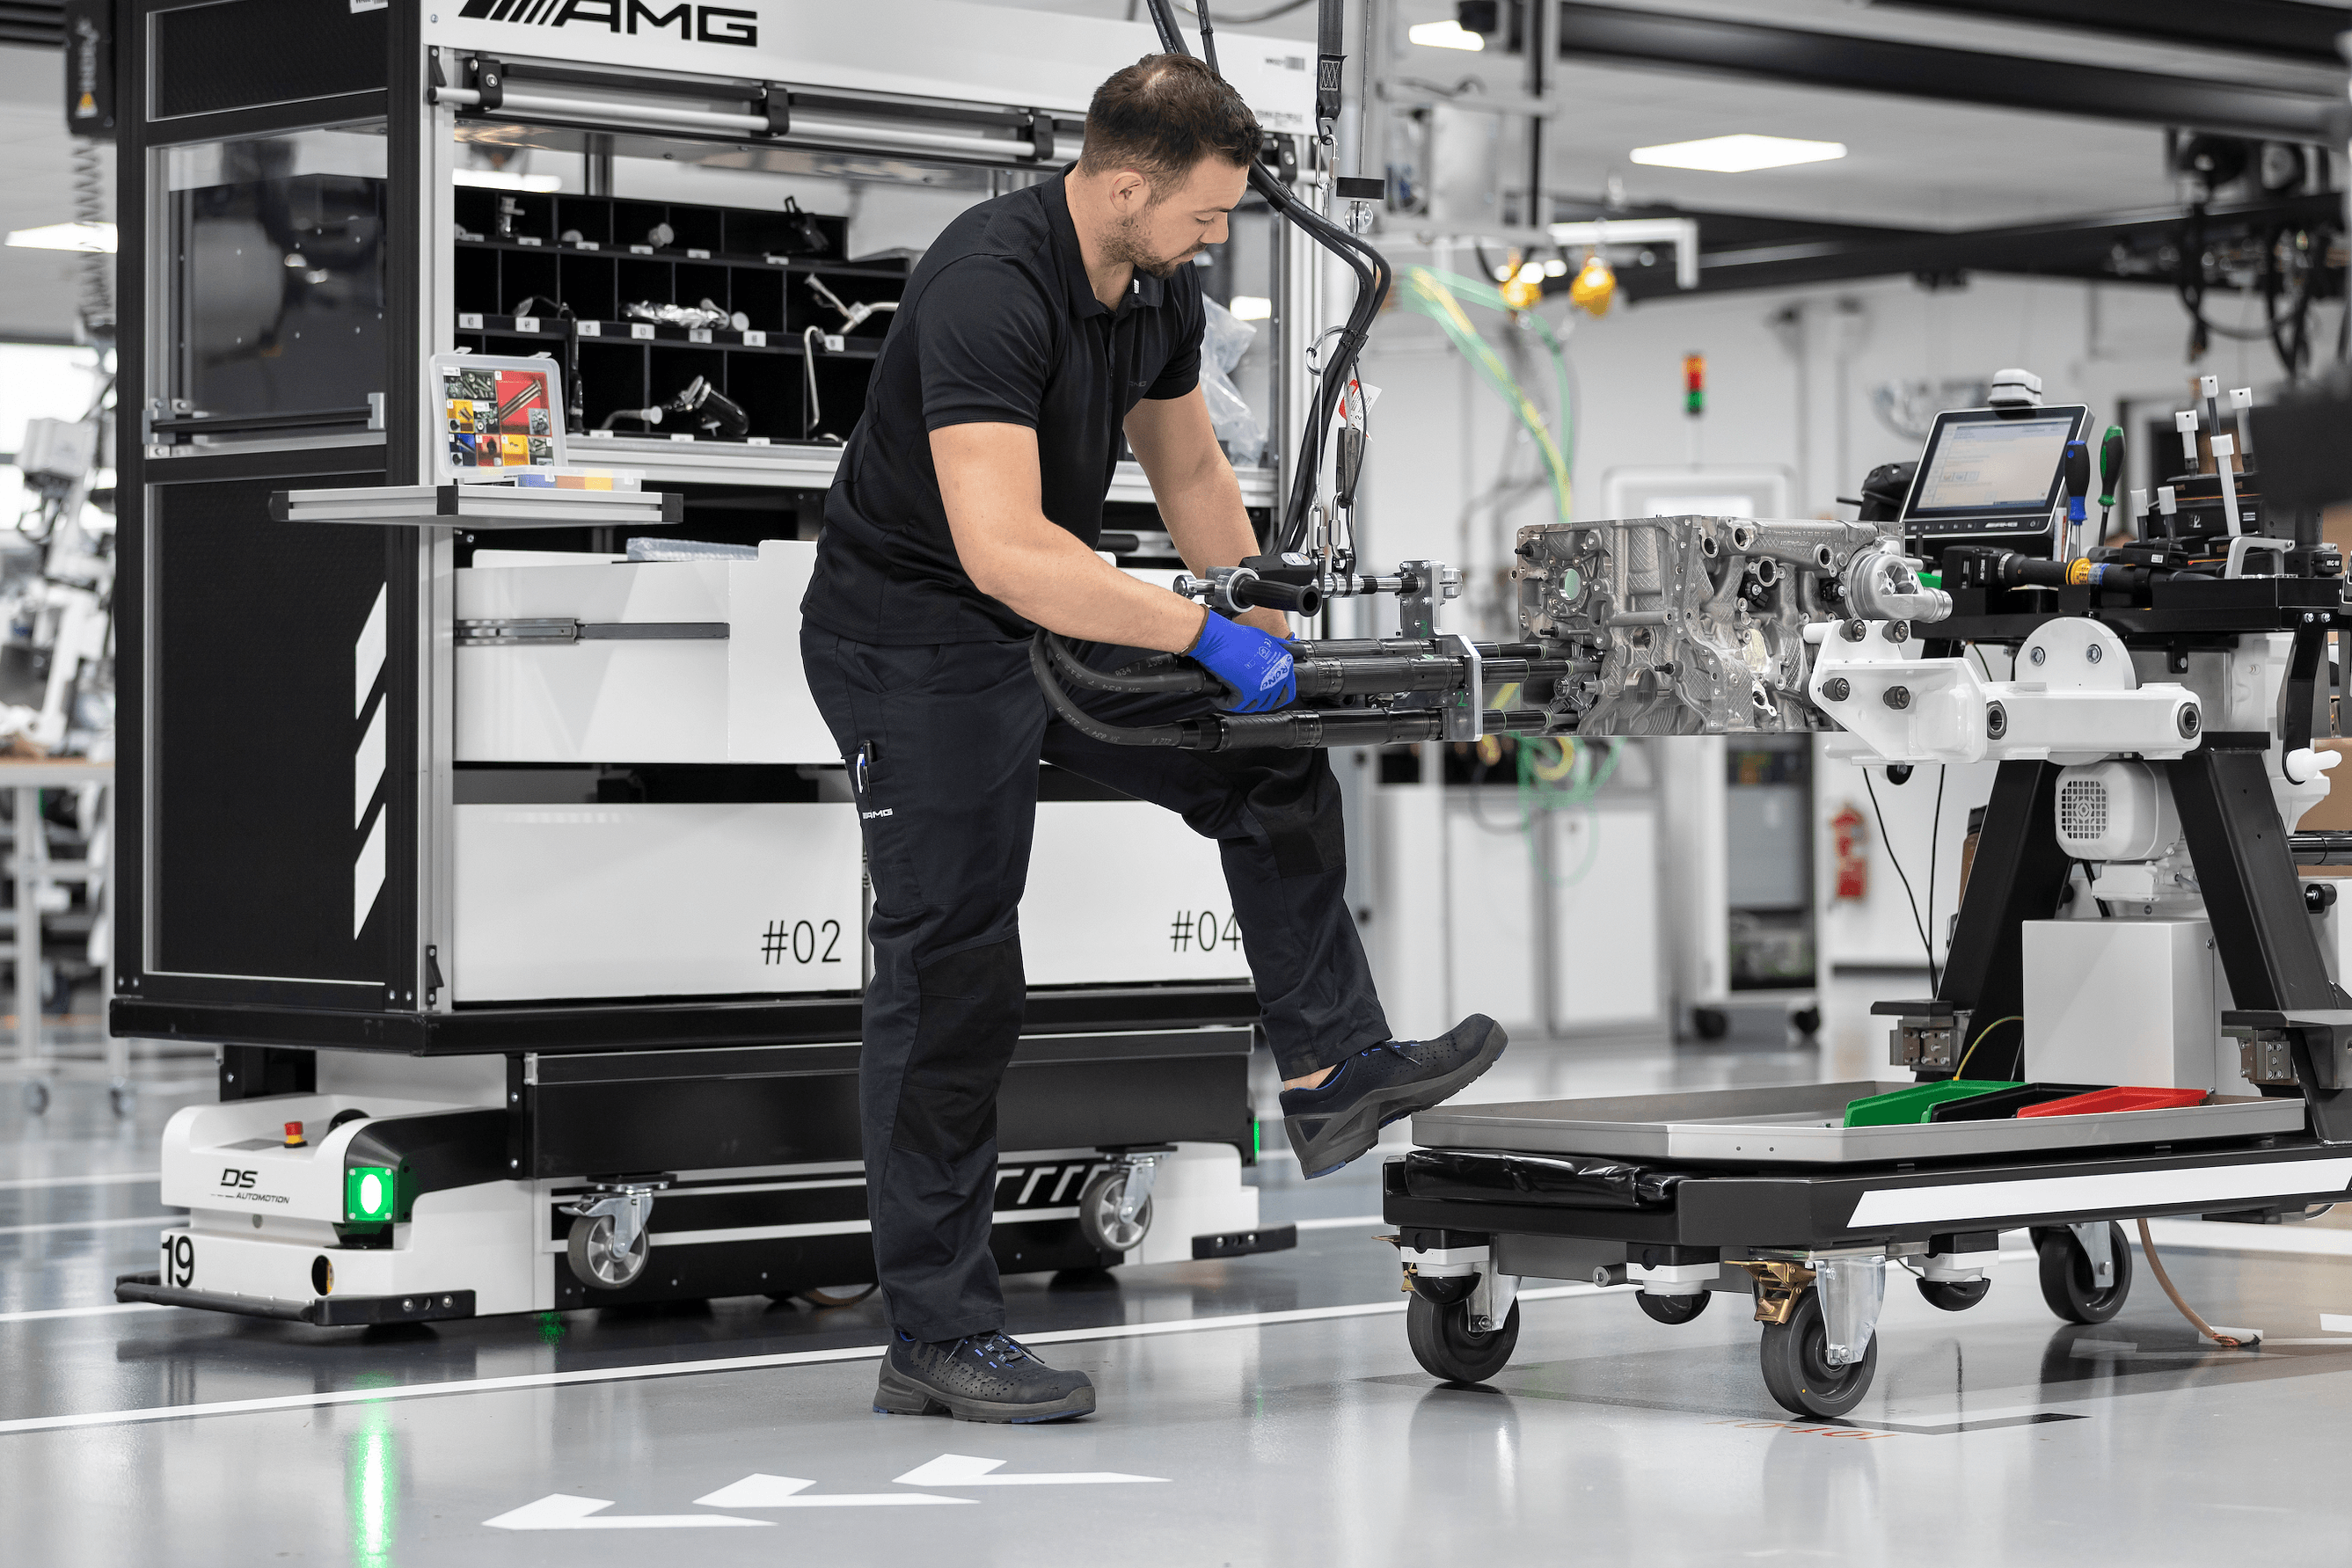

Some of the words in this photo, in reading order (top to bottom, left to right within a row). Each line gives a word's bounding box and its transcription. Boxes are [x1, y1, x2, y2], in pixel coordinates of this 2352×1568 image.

[551, 0, 758, 47] AMG
[1420, 619, 1428, 638] 3
[1457, 690, 1468, 707] 2
[865, 807, 894, 820] AMG
[761, 919, 842, 965] #02
[1170, 910, 1241, 952] #04
[220, 1167, 259, 1189] DS
[236, 1192, 290, 1204] AUTOMOTION
[162, 1235, 195, 1288] 19
